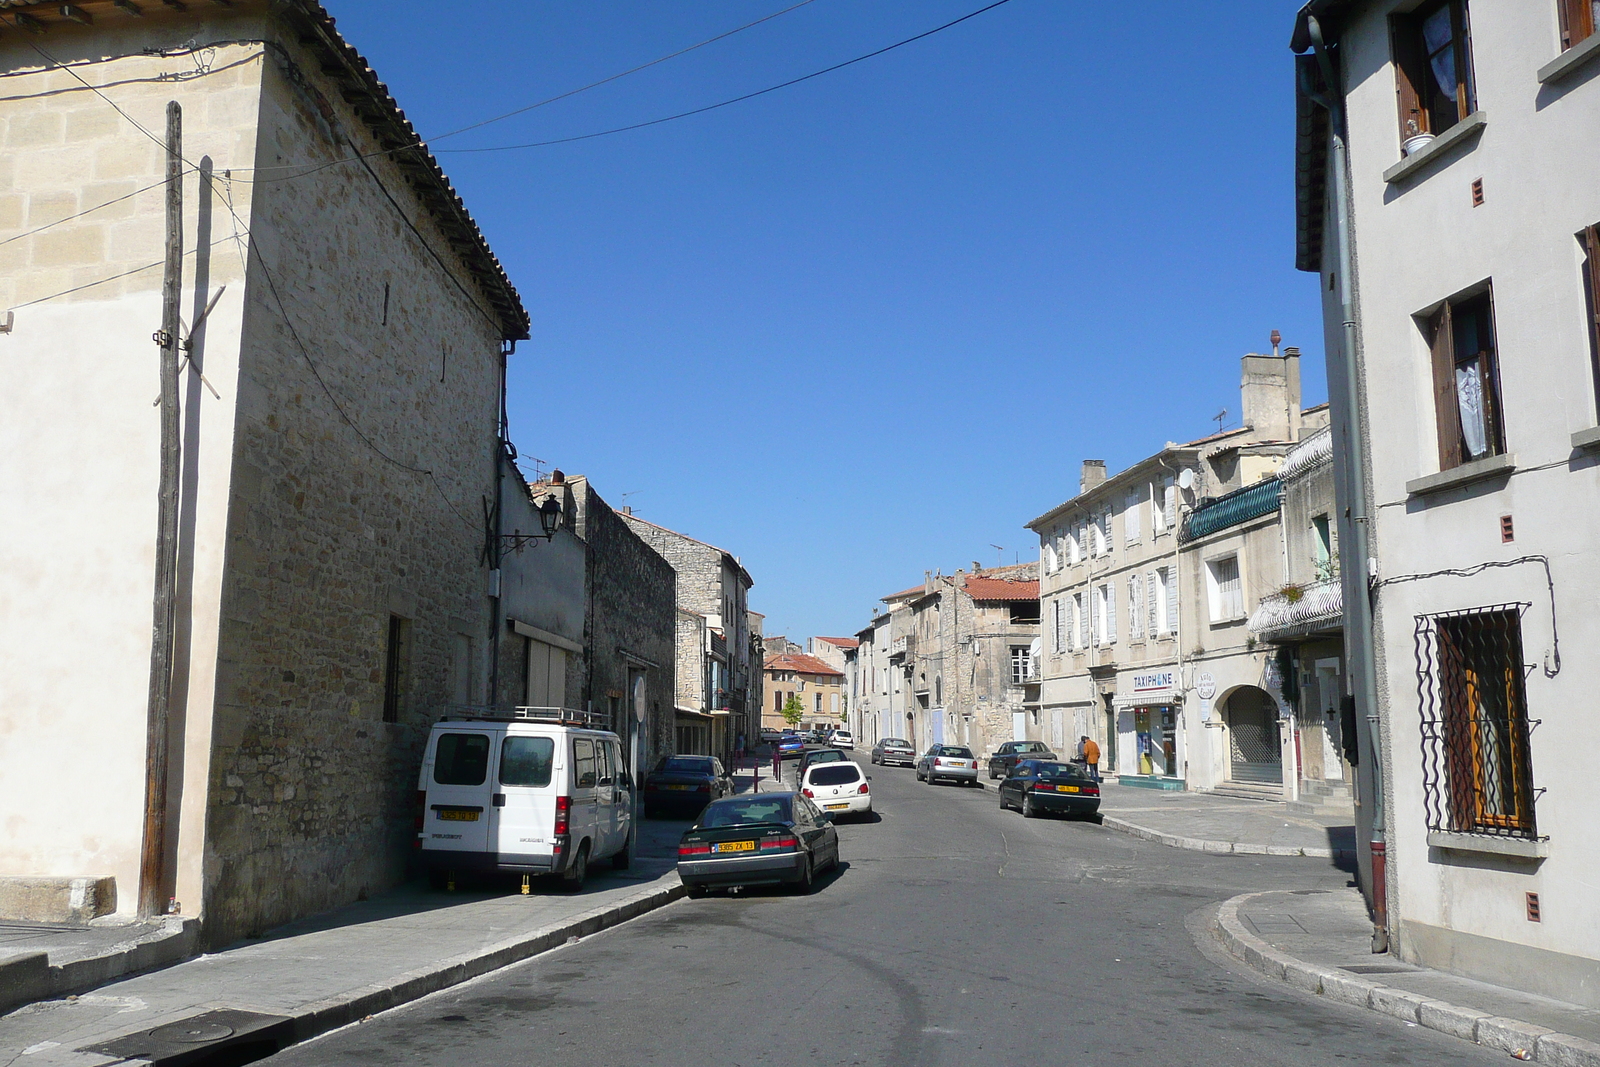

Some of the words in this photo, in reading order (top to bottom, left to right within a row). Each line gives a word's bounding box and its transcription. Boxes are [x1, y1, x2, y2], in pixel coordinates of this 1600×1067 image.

[1134, 673, 1172, 687] TAXIPHONE
[735, 842, 743, 850] ZX
[745, 841, 753, 849] 13
